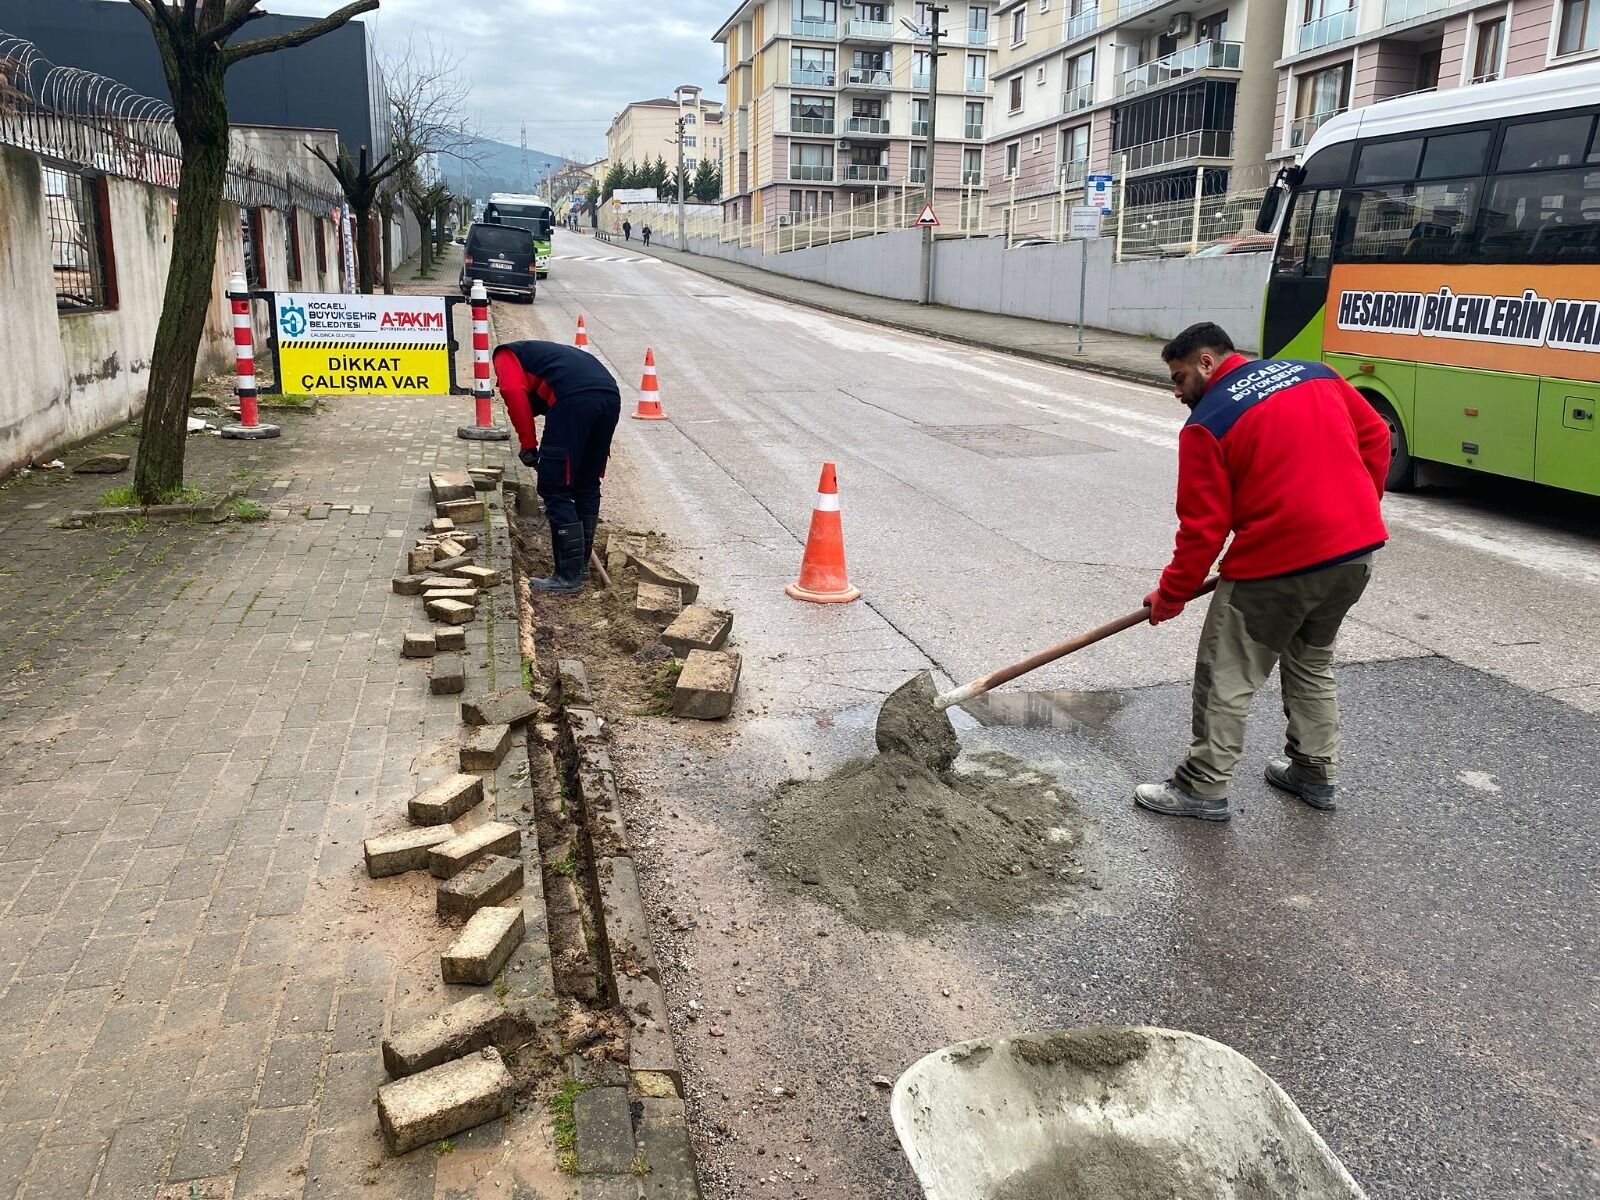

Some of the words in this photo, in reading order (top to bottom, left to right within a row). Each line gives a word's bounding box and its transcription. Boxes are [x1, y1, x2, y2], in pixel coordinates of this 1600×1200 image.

[308, 311, 377, 321] BÜYÜKŞEHİR
[380, 311, 443, 328] A-TAKIMI
[1338, 292, 1421, 330] HESABINI
[1422, 289, 1547, 340] BİLENLERİN
[309, 320, 361, 329] BELEDİYESİ
[328, 354, 401, 372] DİKKAT
[301, 375, 387, 392] ÇALIŞMA
[392, 376, 430, 389] VAR
